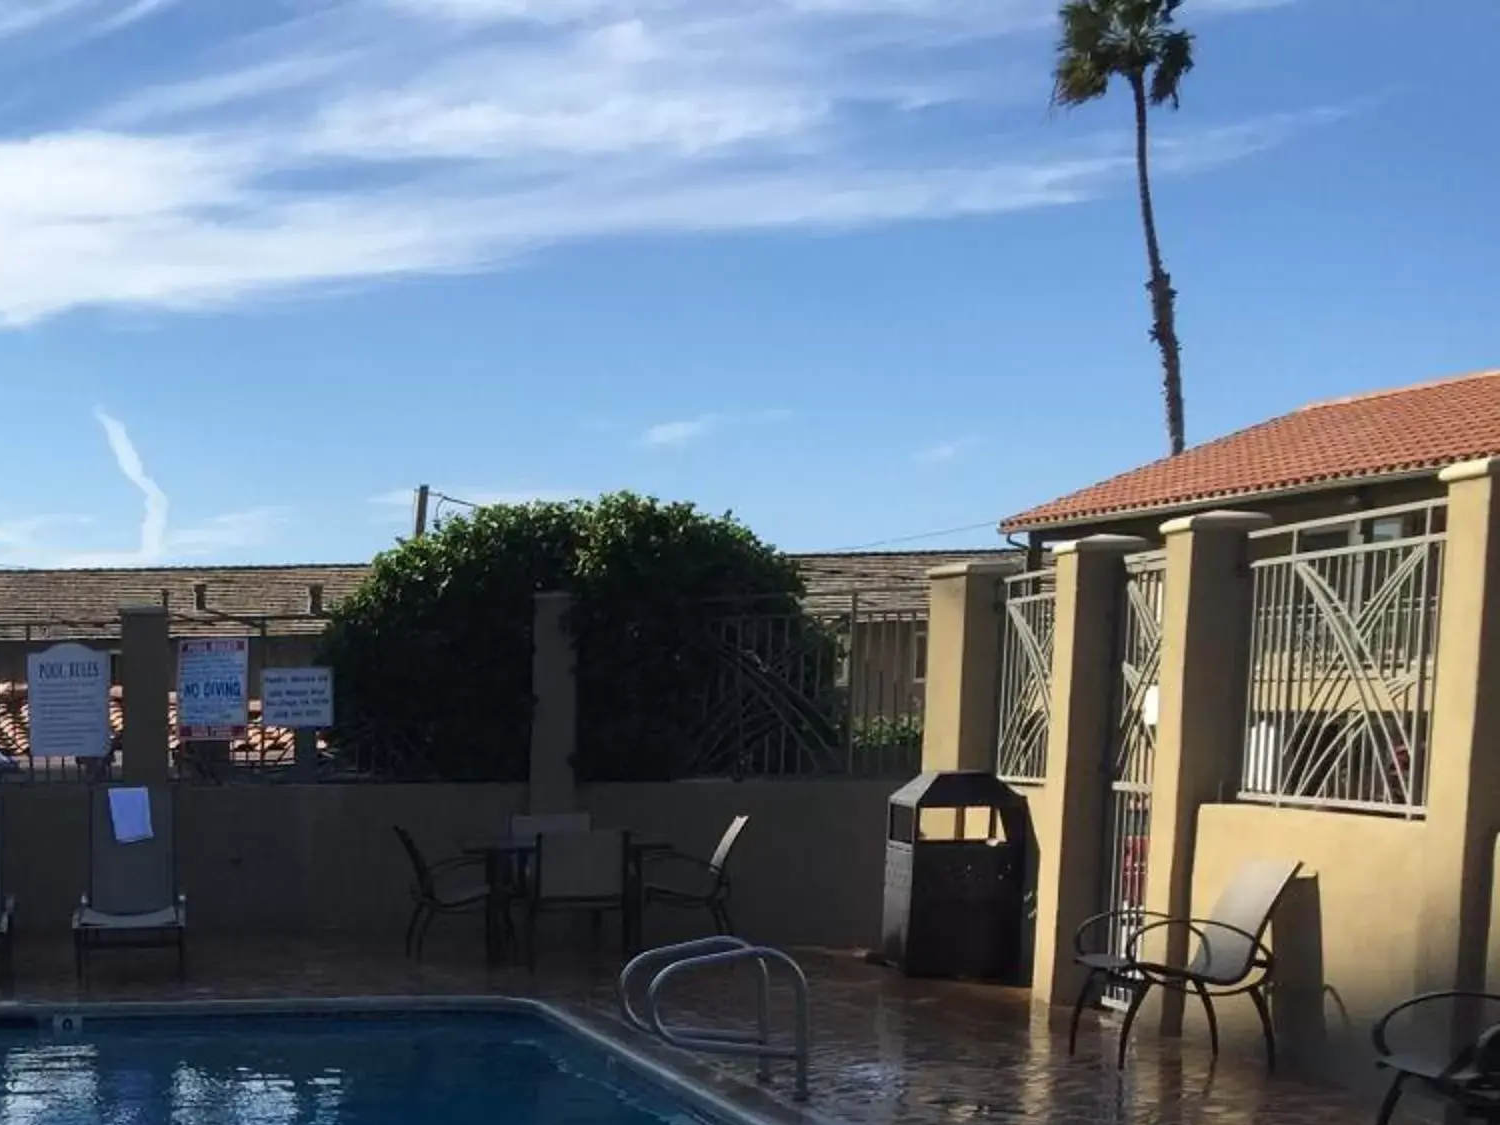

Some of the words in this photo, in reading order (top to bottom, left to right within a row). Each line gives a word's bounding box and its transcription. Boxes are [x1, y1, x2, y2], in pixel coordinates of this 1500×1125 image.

[38, 662, 65, 678] POOL
[69, 662, 98, 677] RULES
[184, 683, 200, 698] NO
[203, 682, 241, 697] DIVING
